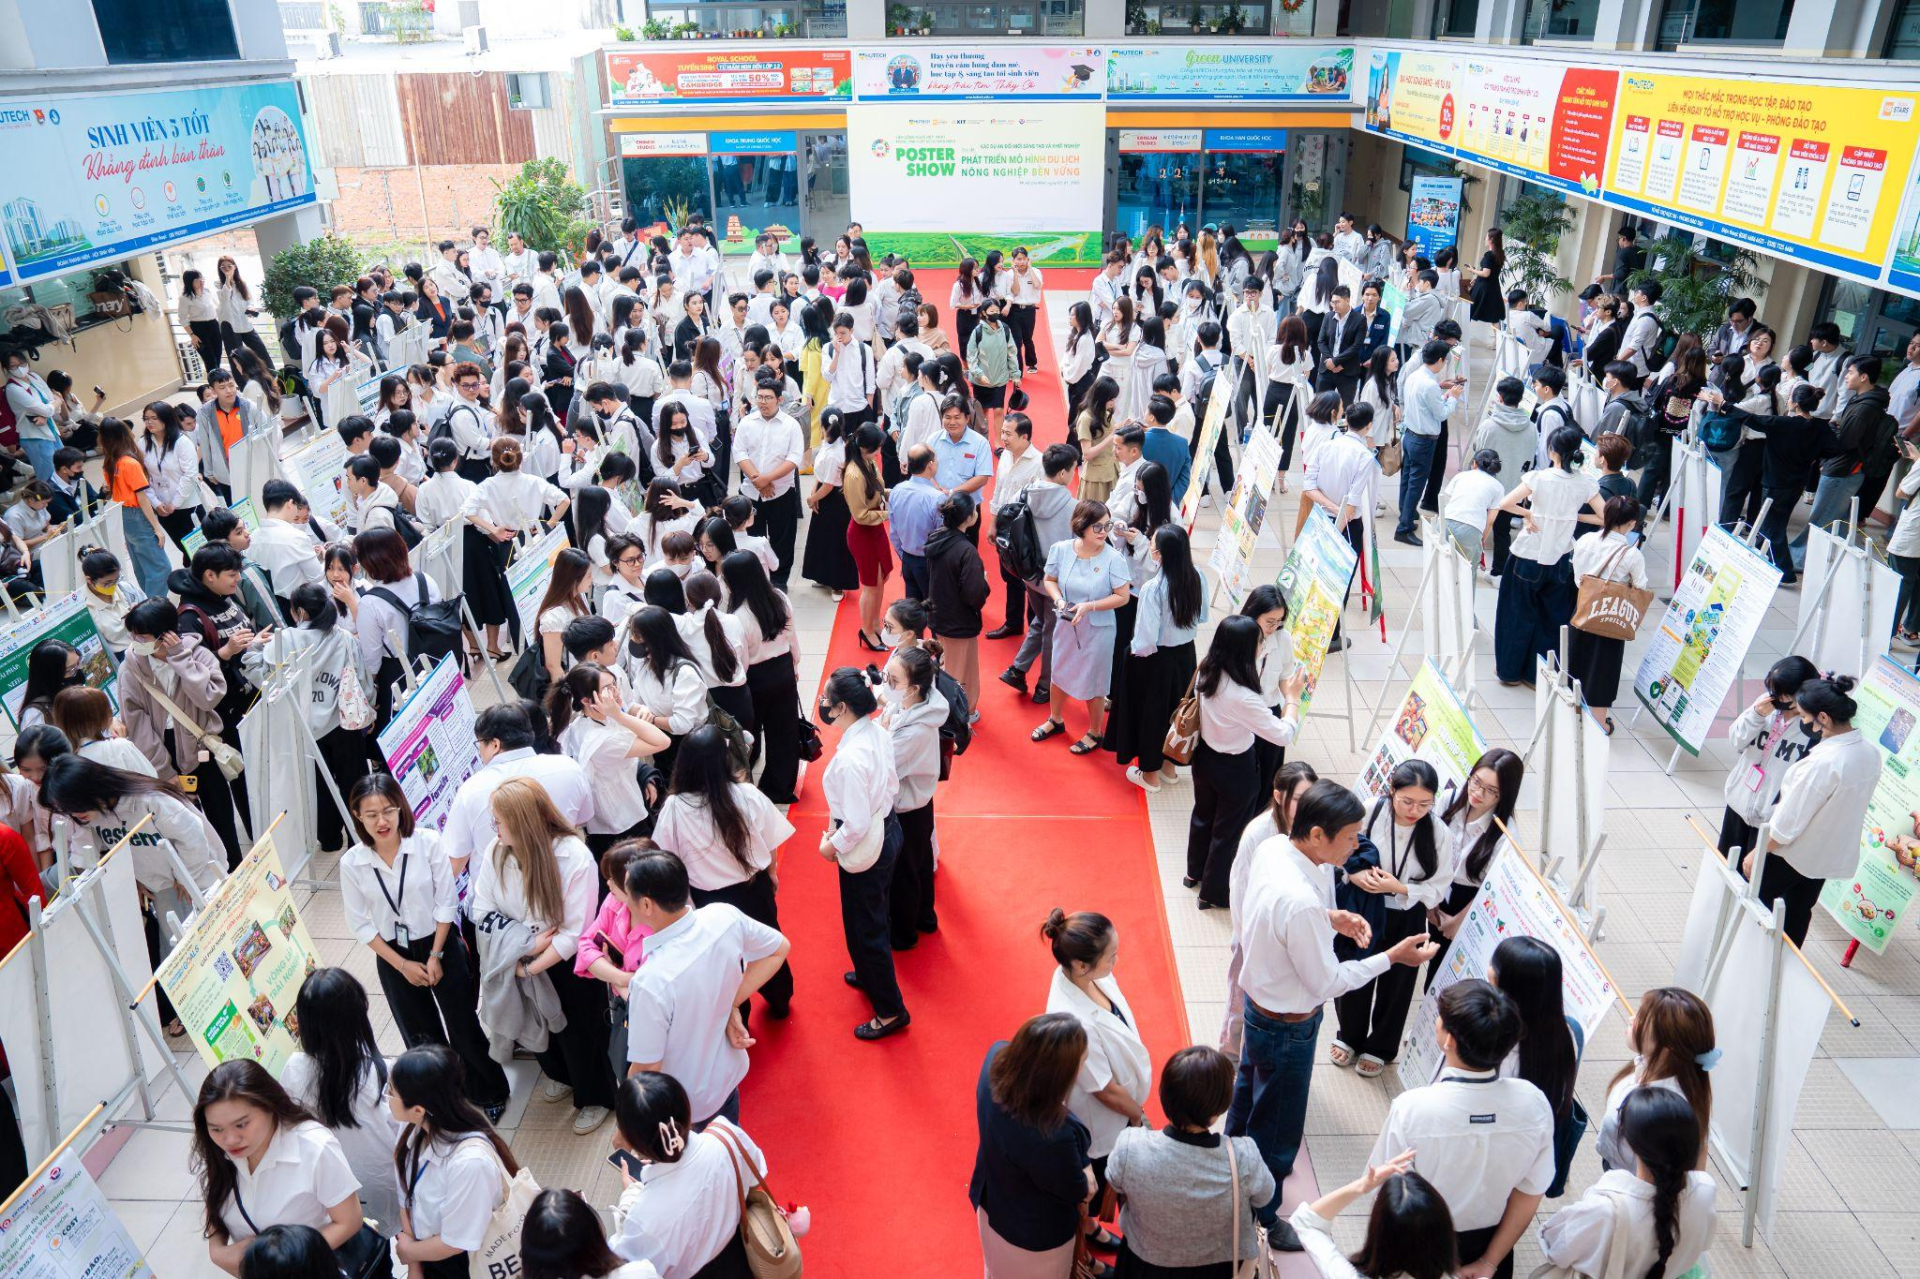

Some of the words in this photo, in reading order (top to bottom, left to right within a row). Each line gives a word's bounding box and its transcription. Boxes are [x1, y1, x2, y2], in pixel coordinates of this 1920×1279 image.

[1185, 50, 1221, 68] Green
[1222, 54, 1273, 64] UNIVERSITY
[1683, 90, 1694, 103] MỌI
[1695, 88, 1710, 101] THẮC
[1711, 89, 1725, 103] MẮC
[1726, 94, 1747, 106] TRONG
[1748, 96, 1763, 109] HỌC
[1779, 96, 1796, 110] ĐÀO
[1798, 101, 1812, 114] TẠO
[1894, 106, 1909, 114] STARS
[87, 124, 129, 149] SINH
[130, 116, 168, 143] VIÊN
[169, 119, 179, 138] 5
[181, 108, 210, 136] TỐT
[1668, 102, 1679, 112] LIÊN
[1679, 104, 1687, 116] HỆ
[1688, 106, 1703, 116] NGAY
[1723, 109, 1735, 122] TRỢ
[1736, 112, 1751, 124] HỌC
[1752, 113, 1761, 126] VỤ
[1766, 113, 1792, 128] PHÒNG
[1792, 115, 1810, 129] ĐÀO
[1811, 120, 1826, 134] TẠO
[82, 151, 135, 184] Khẳng
[138, 144, 168, 172] định
[172, 142, 196, 164] bản
[198, 138, 225, 160] thân
[896, 148, 955, 161] POSTER
[961, 155, 982, 165] PHÁT
[984, 153, 1007, 164] TRIỂN
[1009, 154, 1024, 163] MÔ
[1025, 154, 1045, 163] HÌNH
[1047, 155, 1060, 163] DU
[1062, 155, 1080, 165] LỊCH
[906, 163, 956, 176] SHOW
[961, 167, 989, 177] NÔNG
[993, 167, 1029, 179] NGHIỆP
[1032, 166, 1050, 176] BỀN
[1054, 165, 1080, 176] VỮNG
[1159, 166, 1190, 179] 2025
[1588, 597, 1639, 631] LEAGUE
[0, 642, 18, 657] GOALS
[95, 820, 162, 846] estern
[178, 944, 203, 970] GOALS
[263, 959, 289, 985] VÒNG
[60, 1216, 80, 1235] COST
[485, 1234, 507, 1259] MADE
